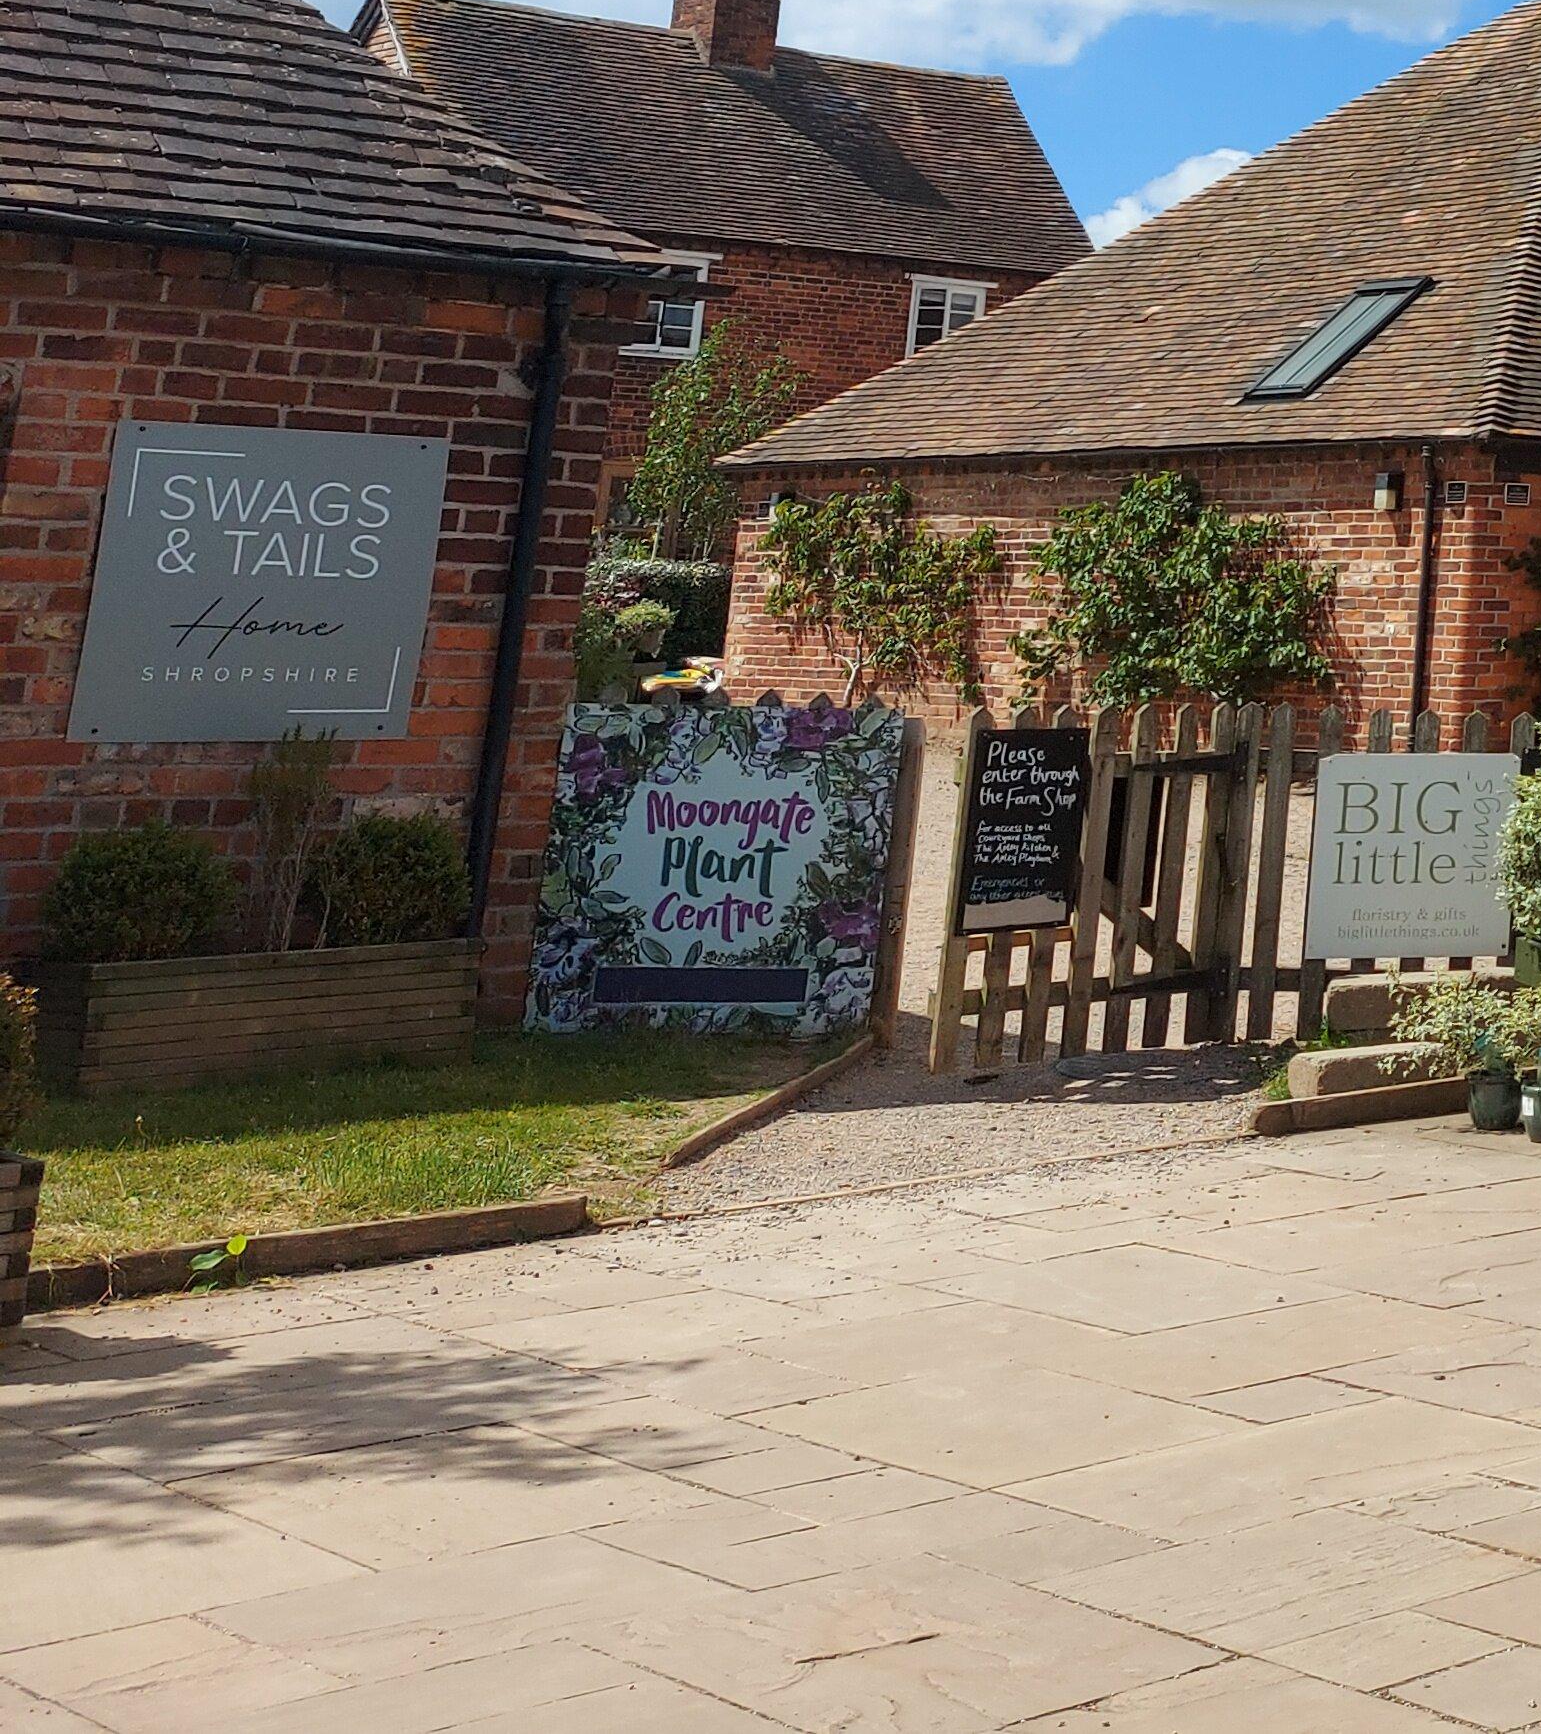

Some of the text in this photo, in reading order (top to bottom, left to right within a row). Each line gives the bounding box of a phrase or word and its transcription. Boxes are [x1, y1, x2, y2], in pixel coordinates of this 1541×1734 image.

[160, 474, 391, 528] SWAGS
[157, 528, 381, 579] & TAILS
[171, 597, 344, 659] Home
[141, 666, 360, 684] SHROPSHIRE
[987, 741, 1045, 767] Please
[982, 765, 1080, 787] enter through
[980, 786, 1077, 816] the Farm Shop
[1333, 781, 1463, 835] BIG
[646, 791, 816, 850] Moongate
[1025, 824, 1033, 832] to
[1038, 823, 1051, 831] all
[660, 836, 789, 899] Plant
[974, 853, 989, 863] The
[1332, 840, 1456, 885] little
[652, 892, 773, 943] Centre
[1337, 924, 1480, 940] biglittlethings.co.uk
[1352, 907, 1467, 923] floristry & gifts
